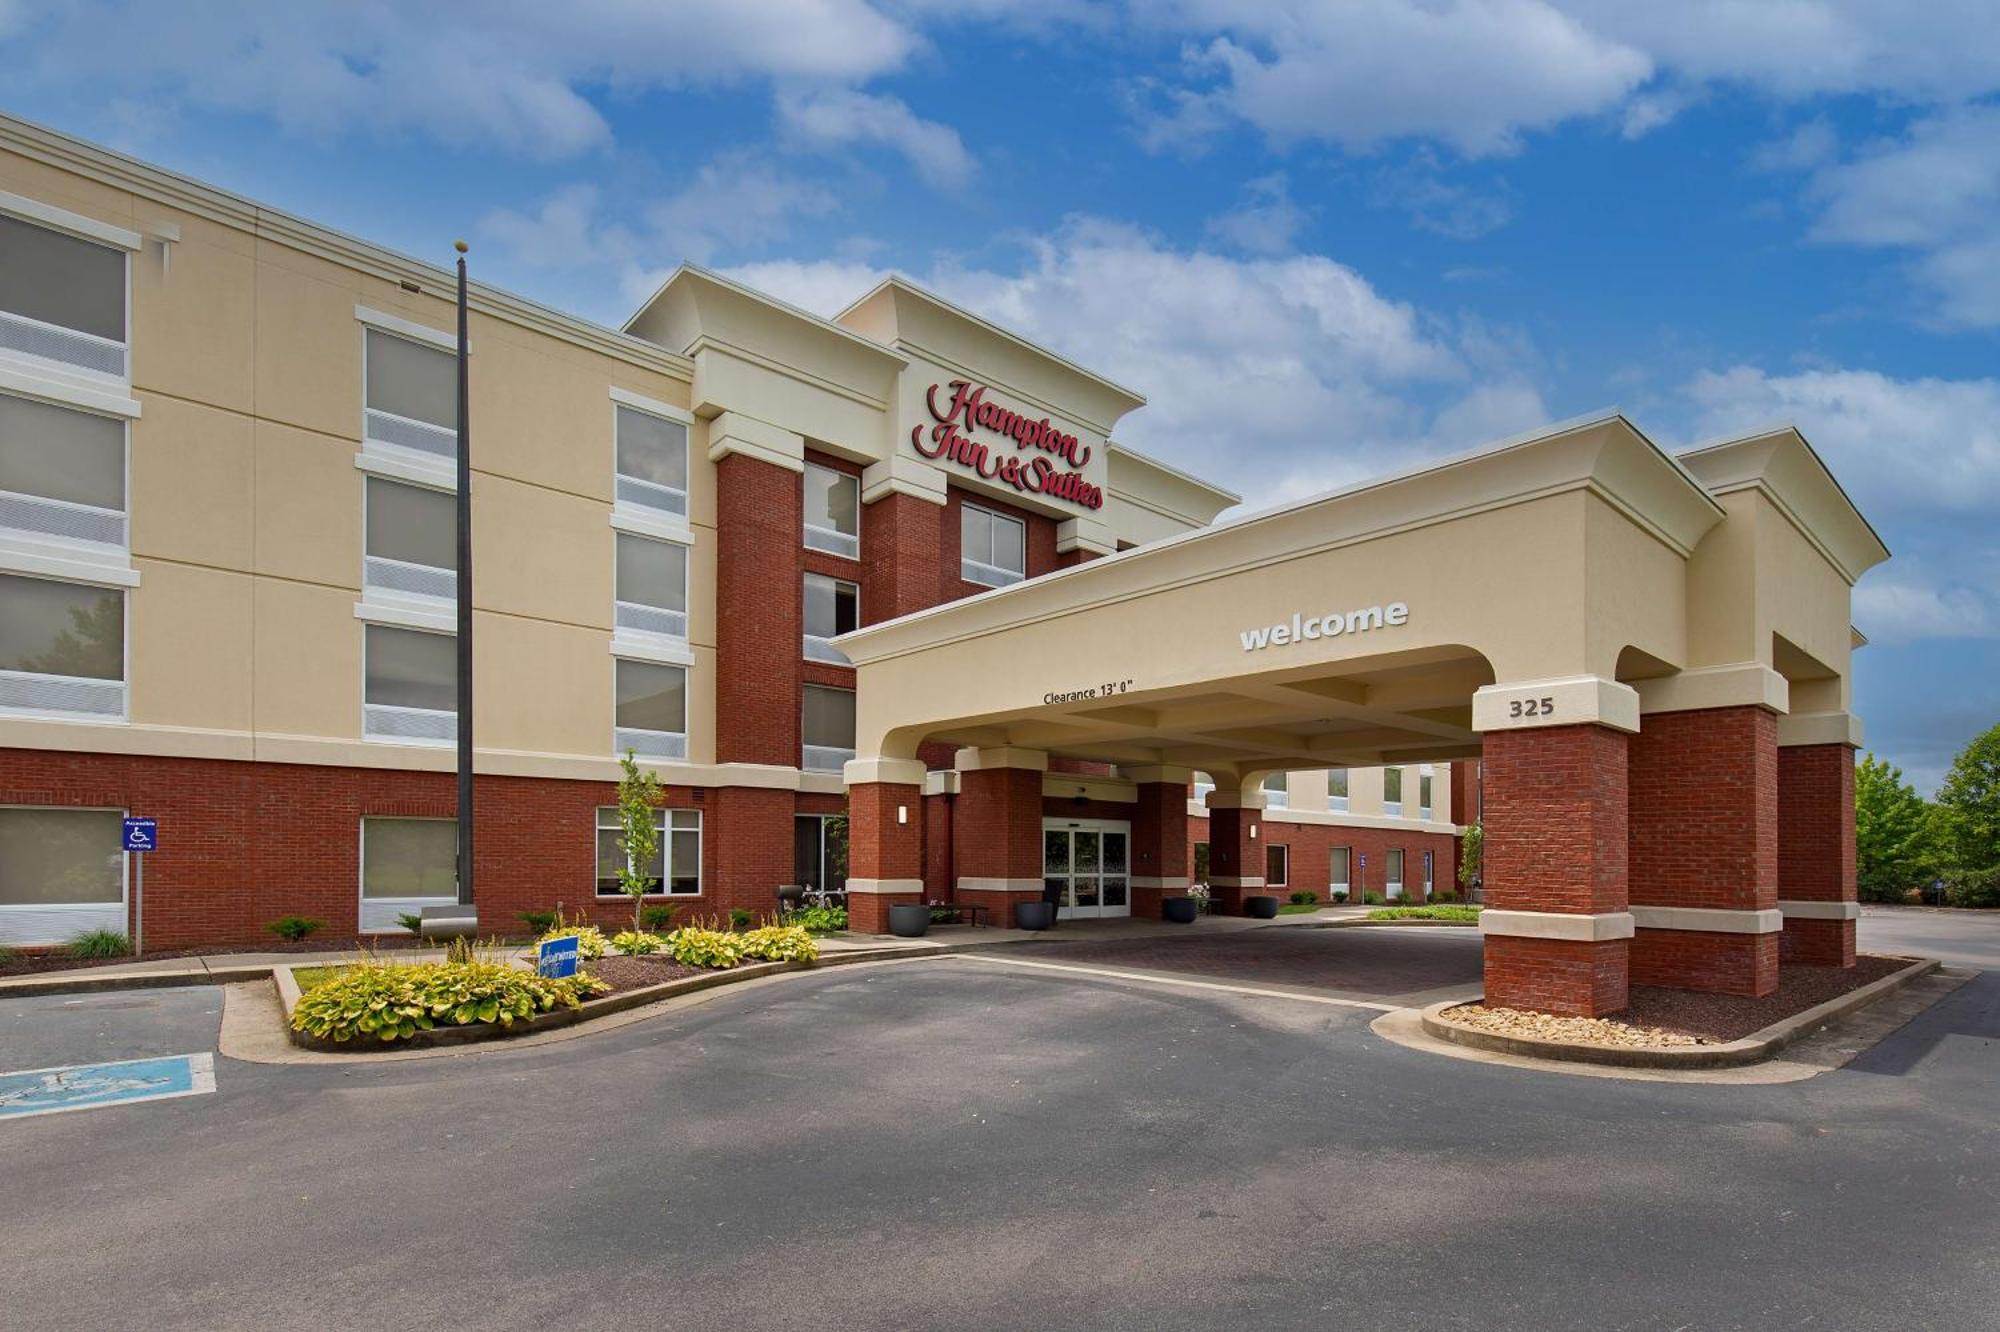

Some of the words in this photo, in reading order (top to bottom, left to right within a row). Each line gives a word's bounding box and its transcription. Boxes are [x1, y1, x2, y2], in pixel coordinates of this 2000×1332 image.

[927, 379, 1091, 468] Hampton
[912, 422, 1004, 480] Inn
[1001, 456, 1026, 492] &
[1020, 456, 1104, 511] Suites
[1239, 601, 1409, 653] welcome
[1043, 688, 1096, 705] Clearance
[1510, 697, 1554, 718] 325
